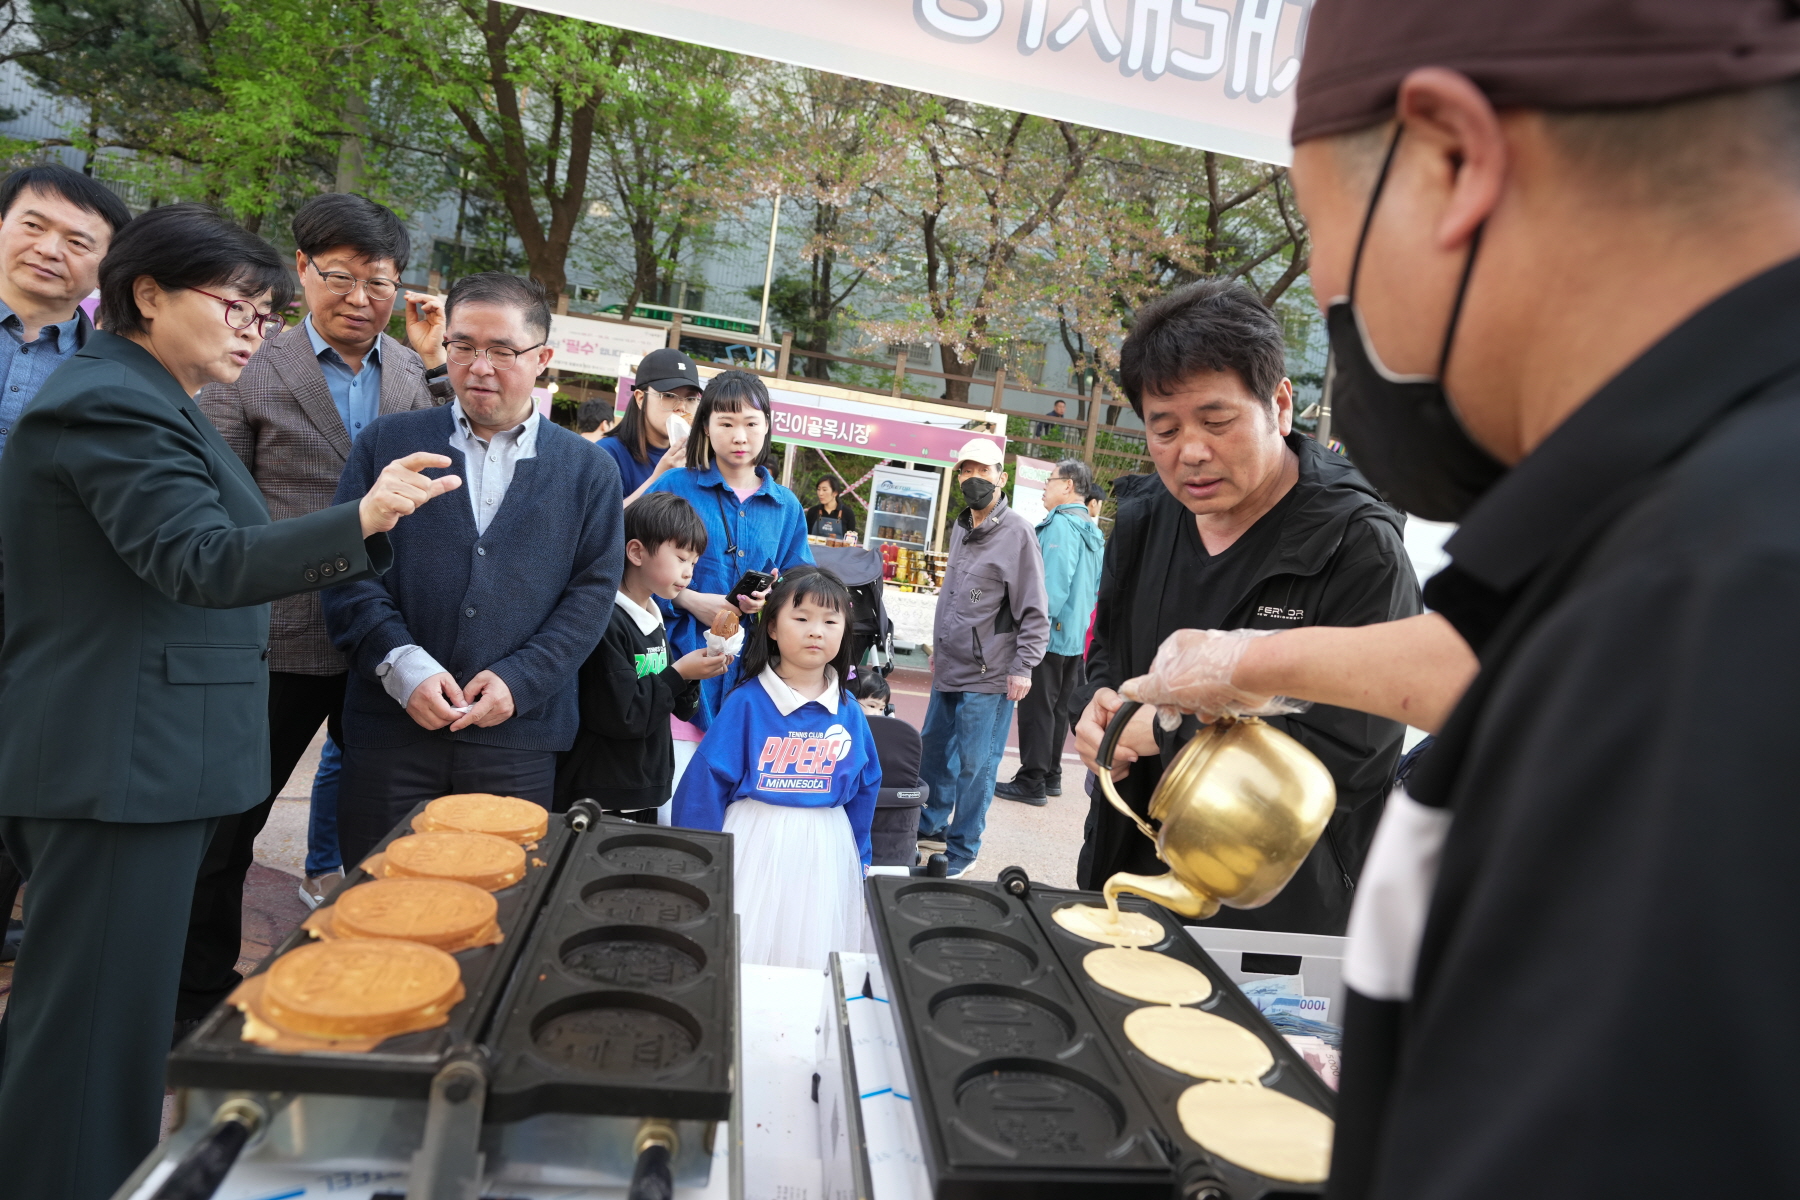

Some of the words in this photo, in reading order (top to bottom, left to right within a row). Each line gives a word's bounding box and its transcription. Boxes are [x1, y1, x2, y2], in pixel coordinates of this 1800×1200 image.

[677, 362, 687, 371] B
[757, 736, 841, 775] PIPERS
[1300, 999, 1326, 1011] 1000
